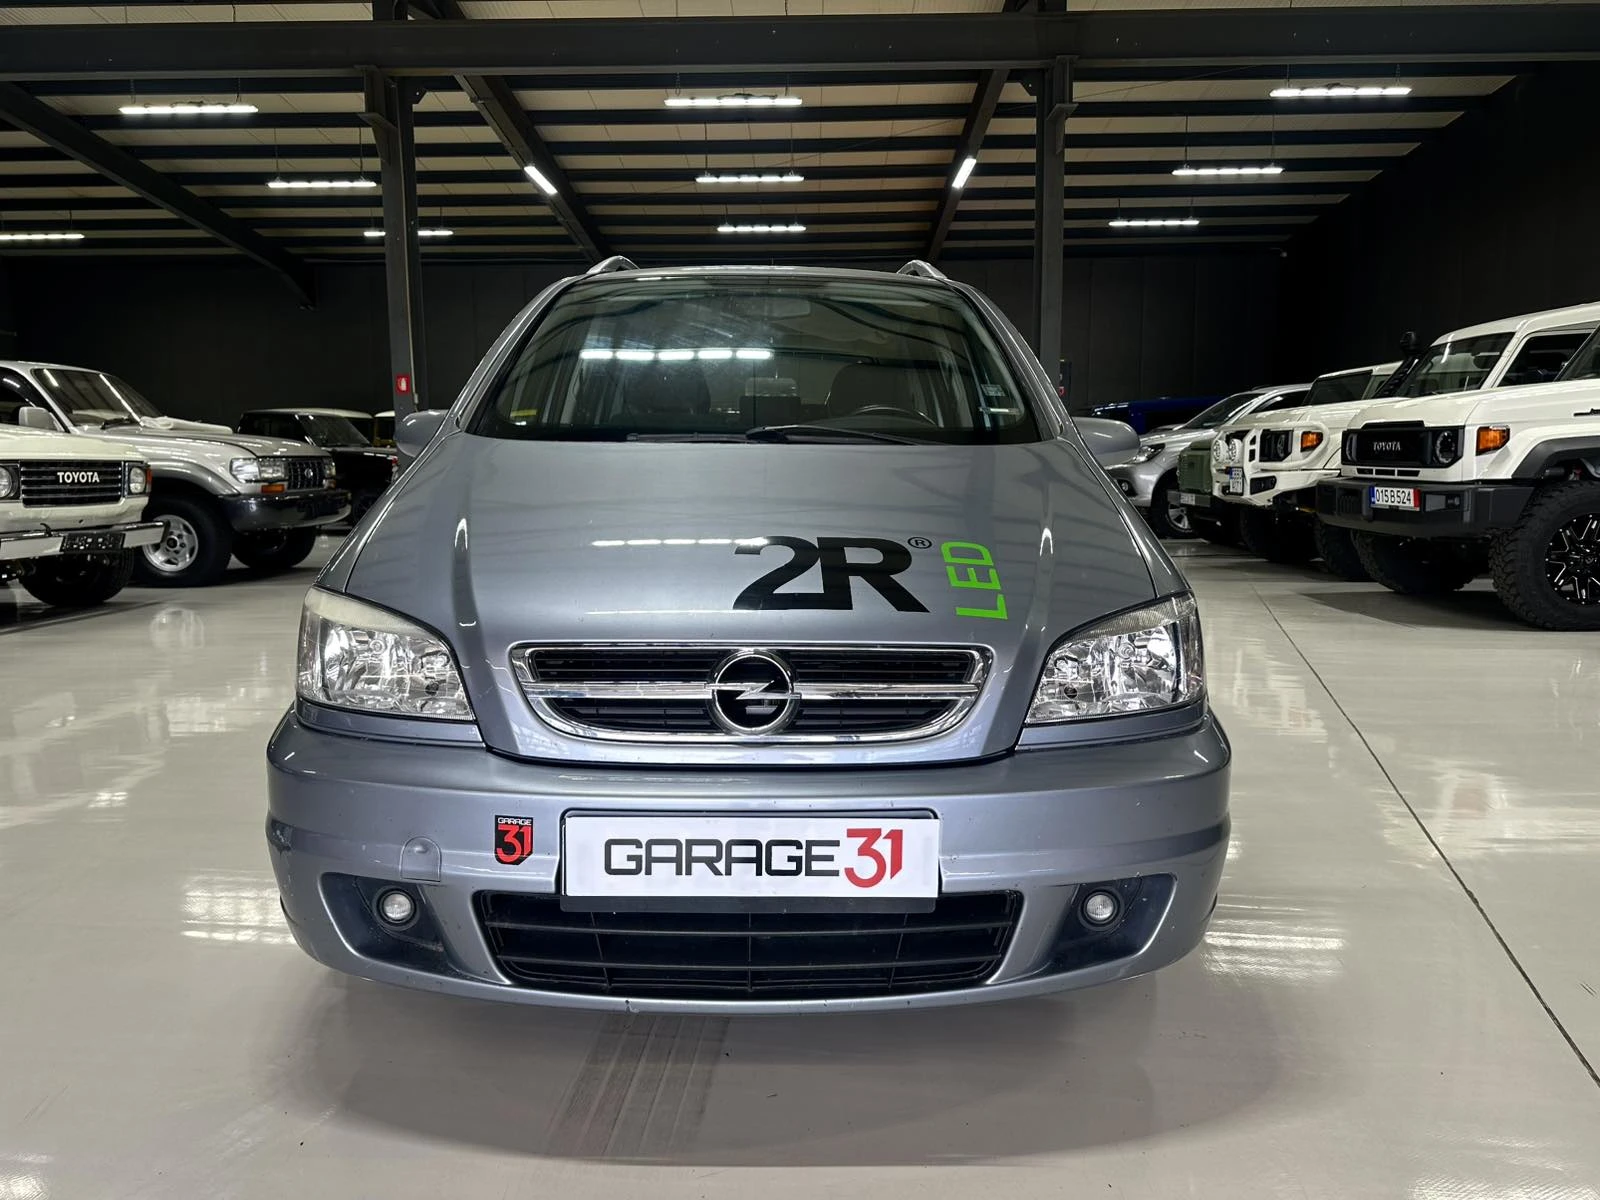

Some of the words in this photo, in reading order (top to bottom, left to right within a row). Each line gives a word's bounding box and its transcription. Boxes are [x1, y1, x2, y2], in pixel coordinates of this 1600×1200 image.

[1373, 441, 1401, 451] TOYOTA
[57, 472, 100, 483] TOYOTA
[941, 541, 1008, 620] LED
[498, 817, 532, 826] GARAGE
[496, 824, 531, 862] 31
